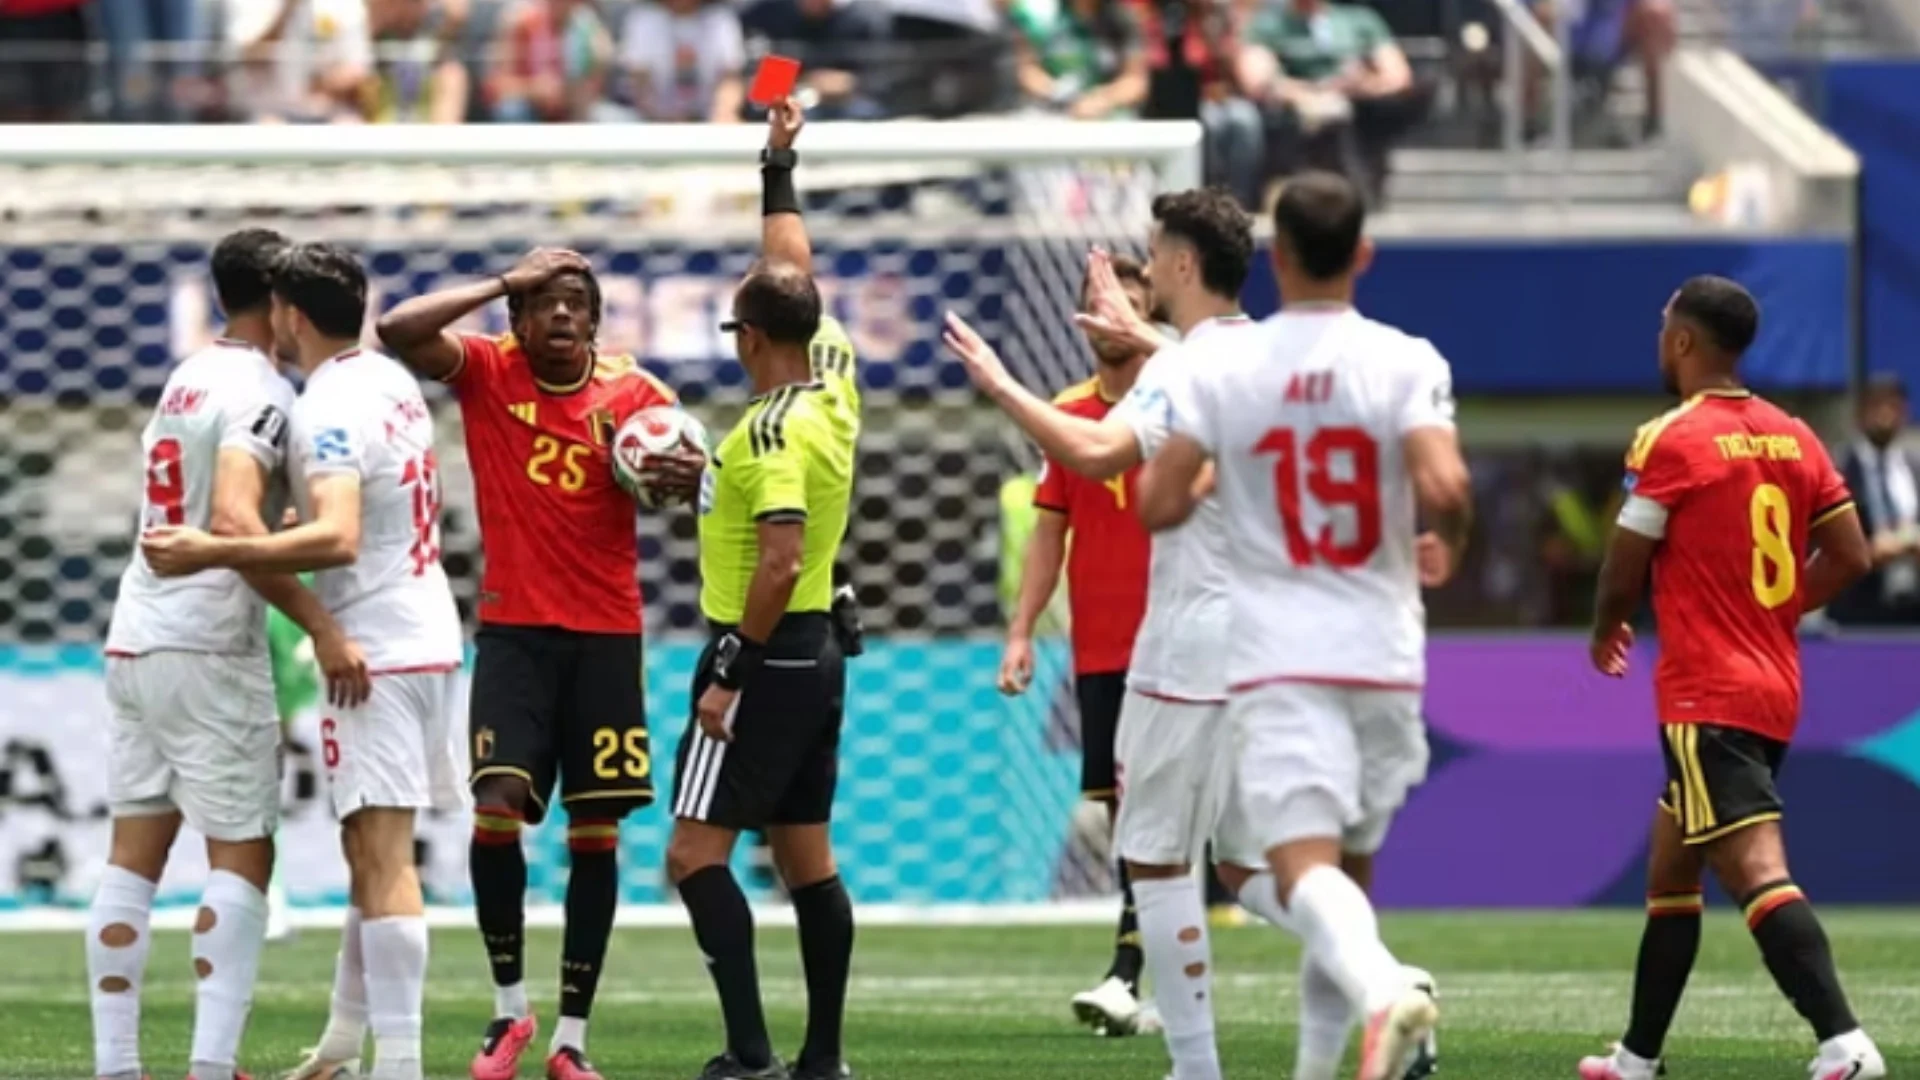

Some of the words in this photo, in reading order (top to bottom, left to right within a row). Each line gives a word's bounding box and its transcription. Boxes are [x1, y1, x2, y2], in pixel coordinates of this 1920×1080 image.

[527, 434, 592, 492] 25
[1250, 425, 1380, 571] 19
[1751, 483, 1796, 610] 8
[321, 717, 341, 768] 6
[593, 727, 650, 779] 25
